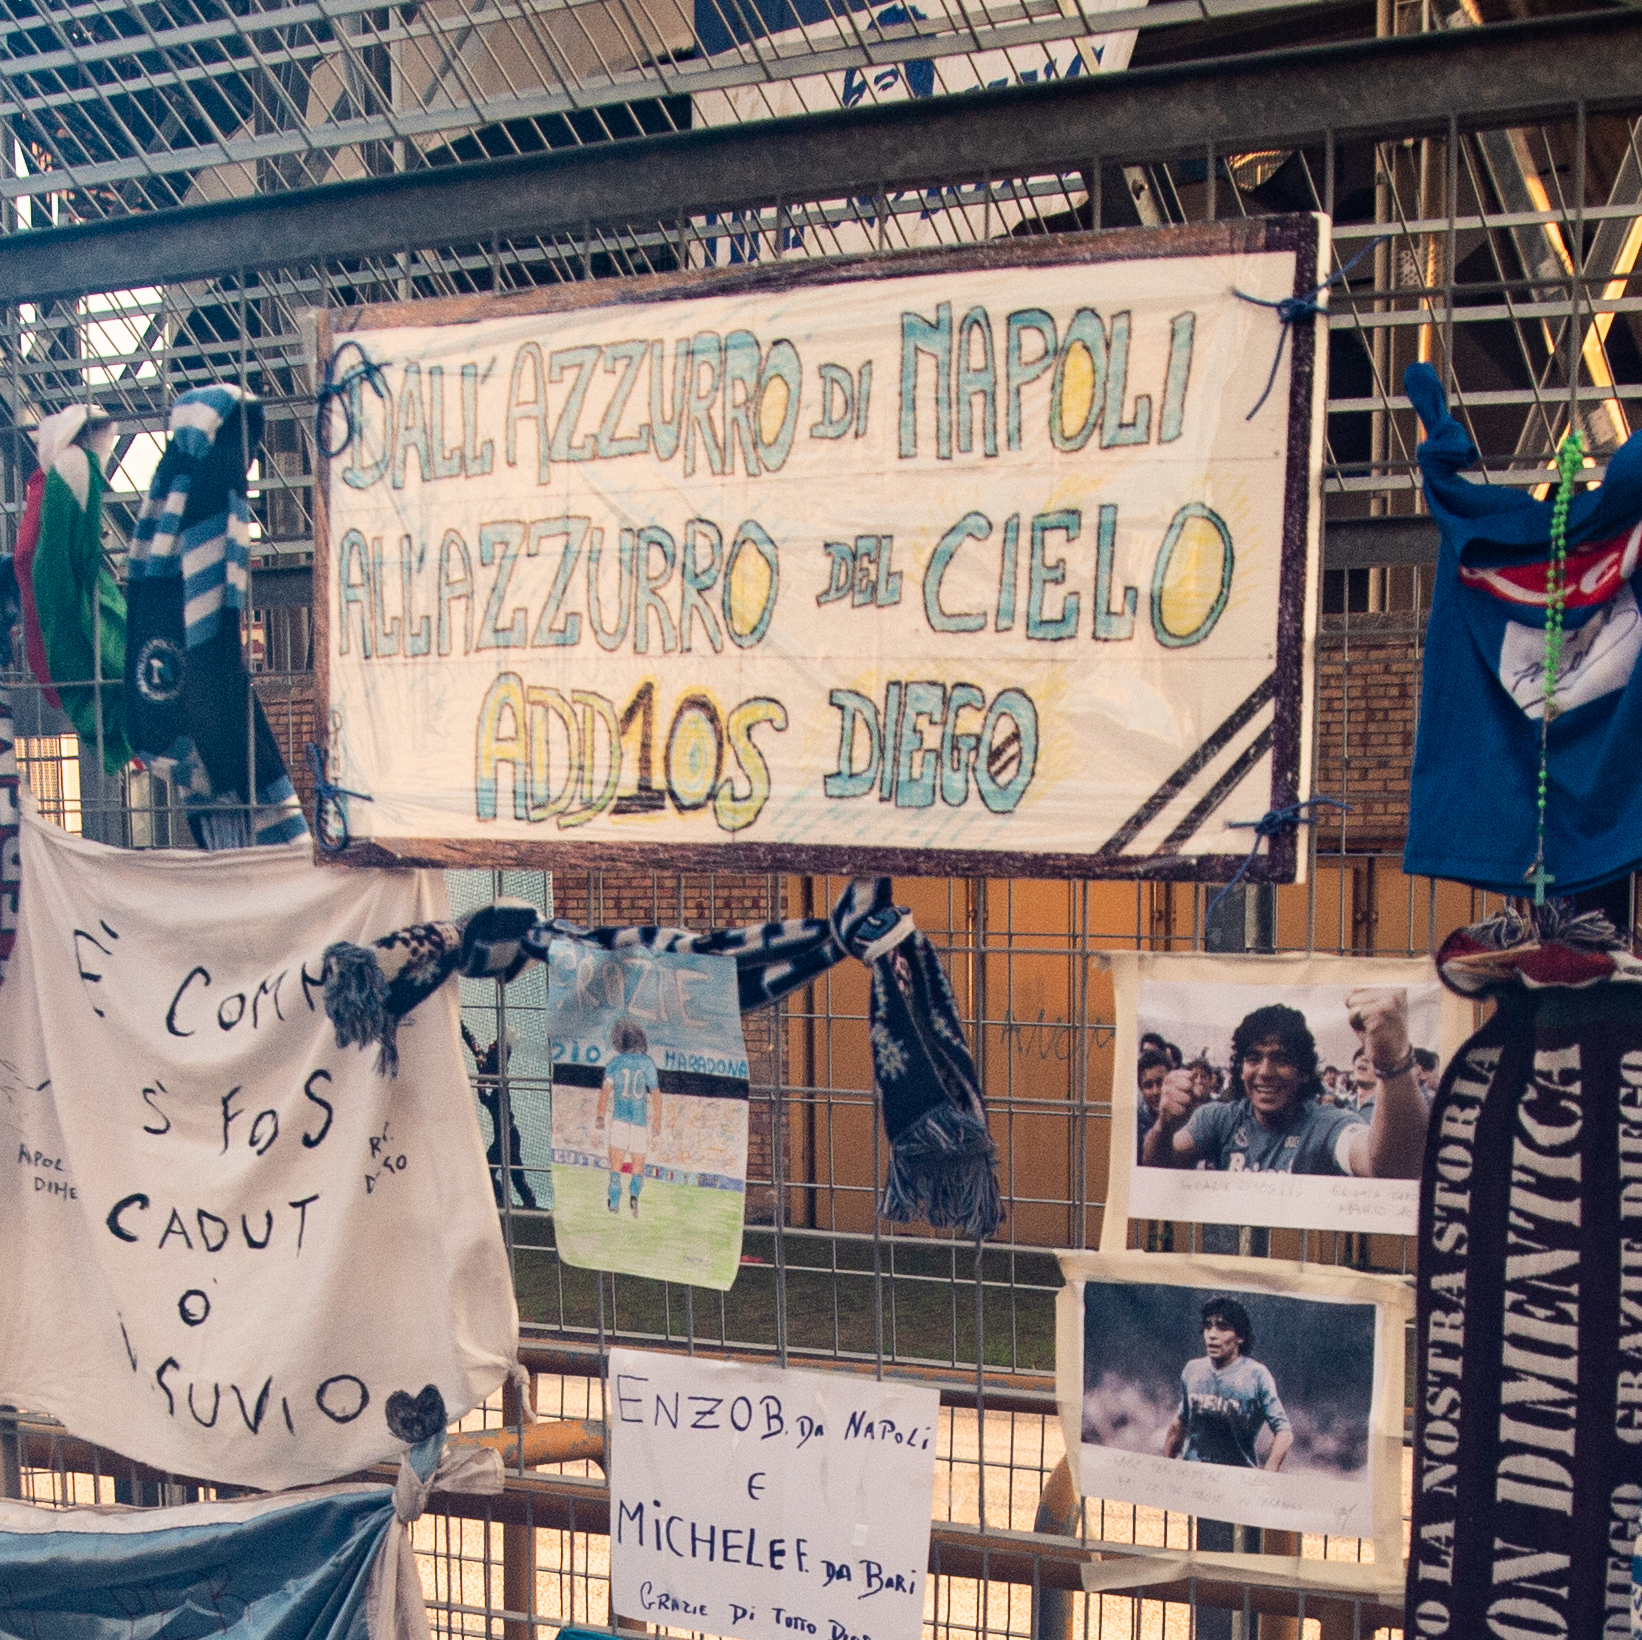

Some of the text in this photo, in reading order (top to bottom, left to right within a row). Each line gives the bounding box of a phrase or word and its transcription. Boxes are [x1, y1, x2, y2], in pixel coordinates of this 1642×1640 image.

[810, 360, 872, 439] DI
[899, 303, 1195, 460] NAPOLI
[817, 535, 902, 607] DEL
[923, 502, 1235, 648] CIELO
[824, 679, 1038, 813] DIEGO
[621, 1068, 645, 1099] 10
[1432, 1044, 1505, 1257] STORIA
[106, 1192, 320, 1257] CADUT
[1496, 1044, 1582, 1517] DIMENTICA
[1422, 1269, 1469, 1497] NOSTRA
[1418, 1519, 1455, 1587] LA
